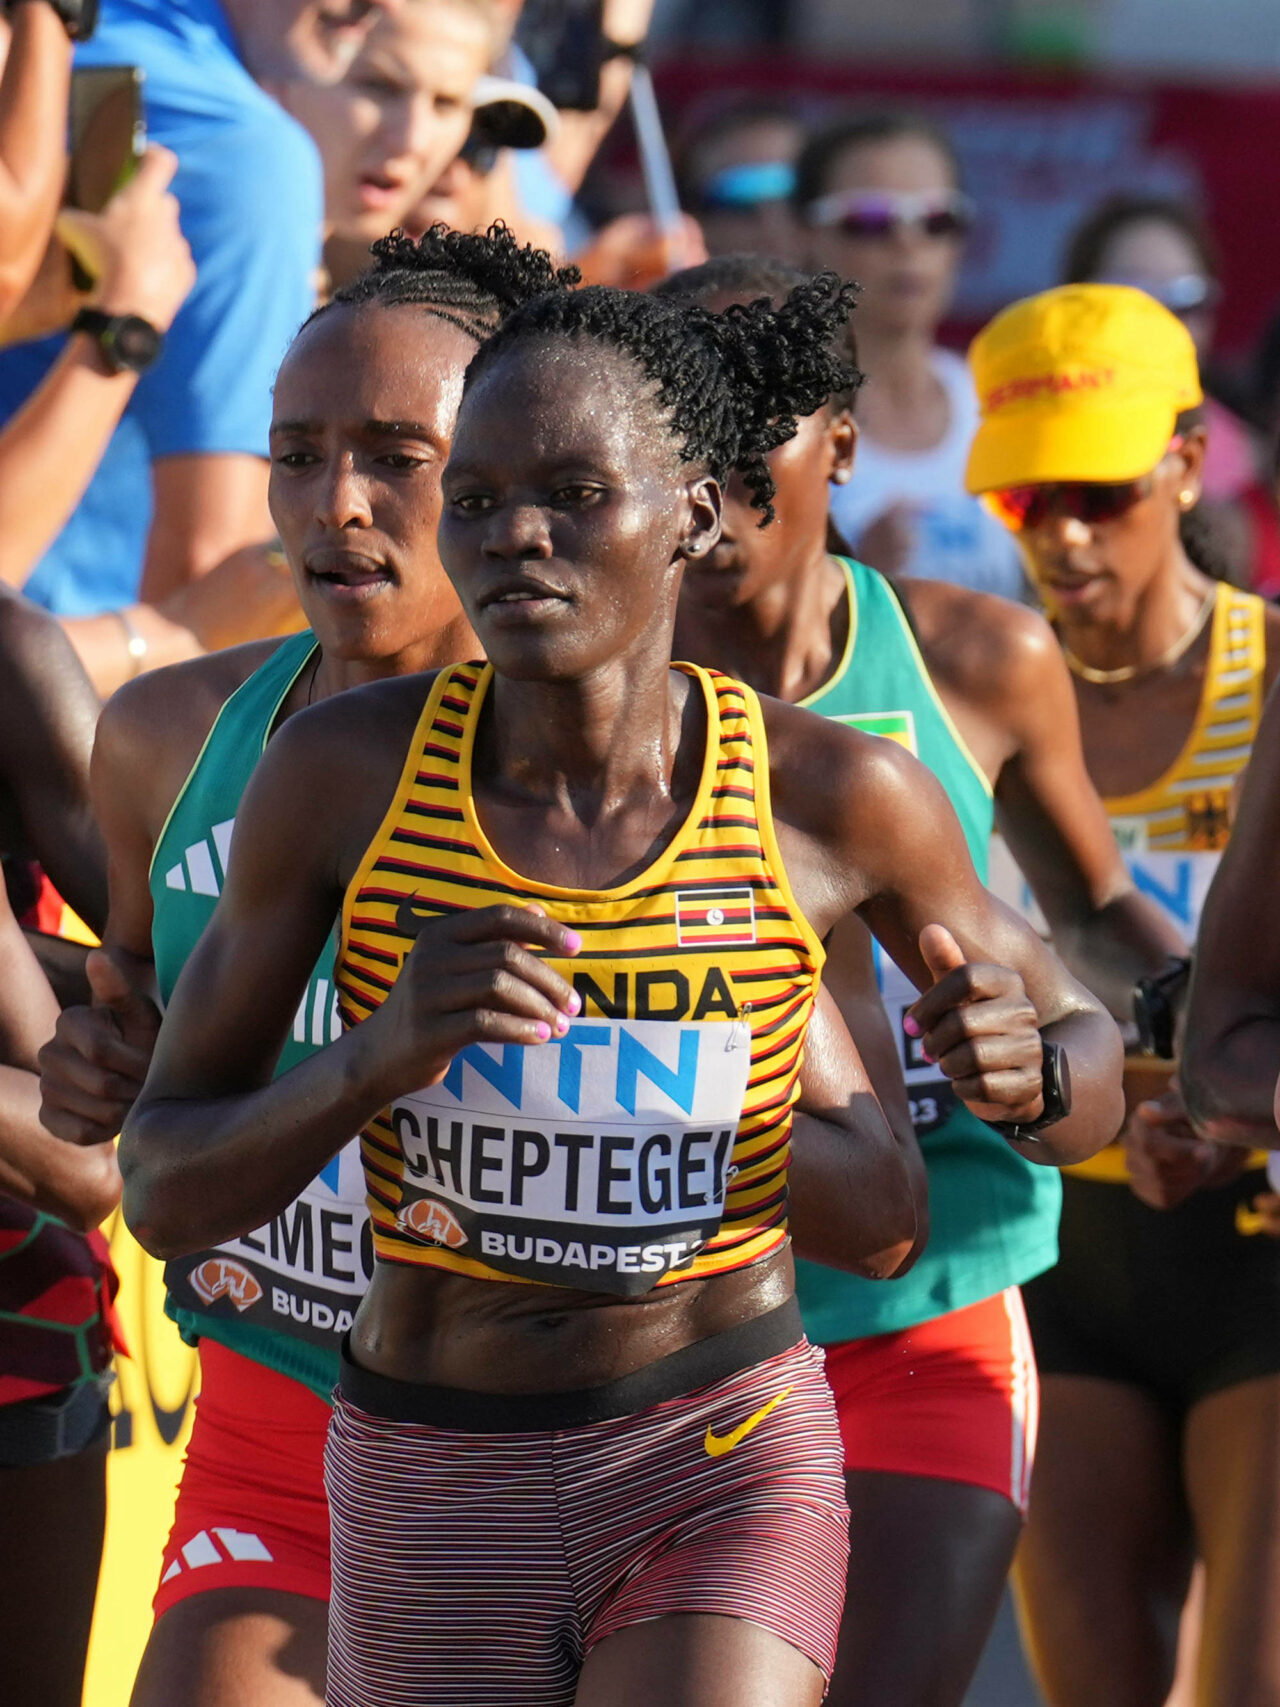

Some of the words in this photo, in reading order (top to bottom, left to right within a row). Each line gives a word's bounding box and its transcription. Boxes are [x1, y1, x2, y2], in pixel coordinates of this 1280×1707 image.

[443, 1024, 700, 1117] NTN
[391, 1108, 732, 1215] CHEPTEGEI
[480, 1231, 692, 1274] BUDAPEST
